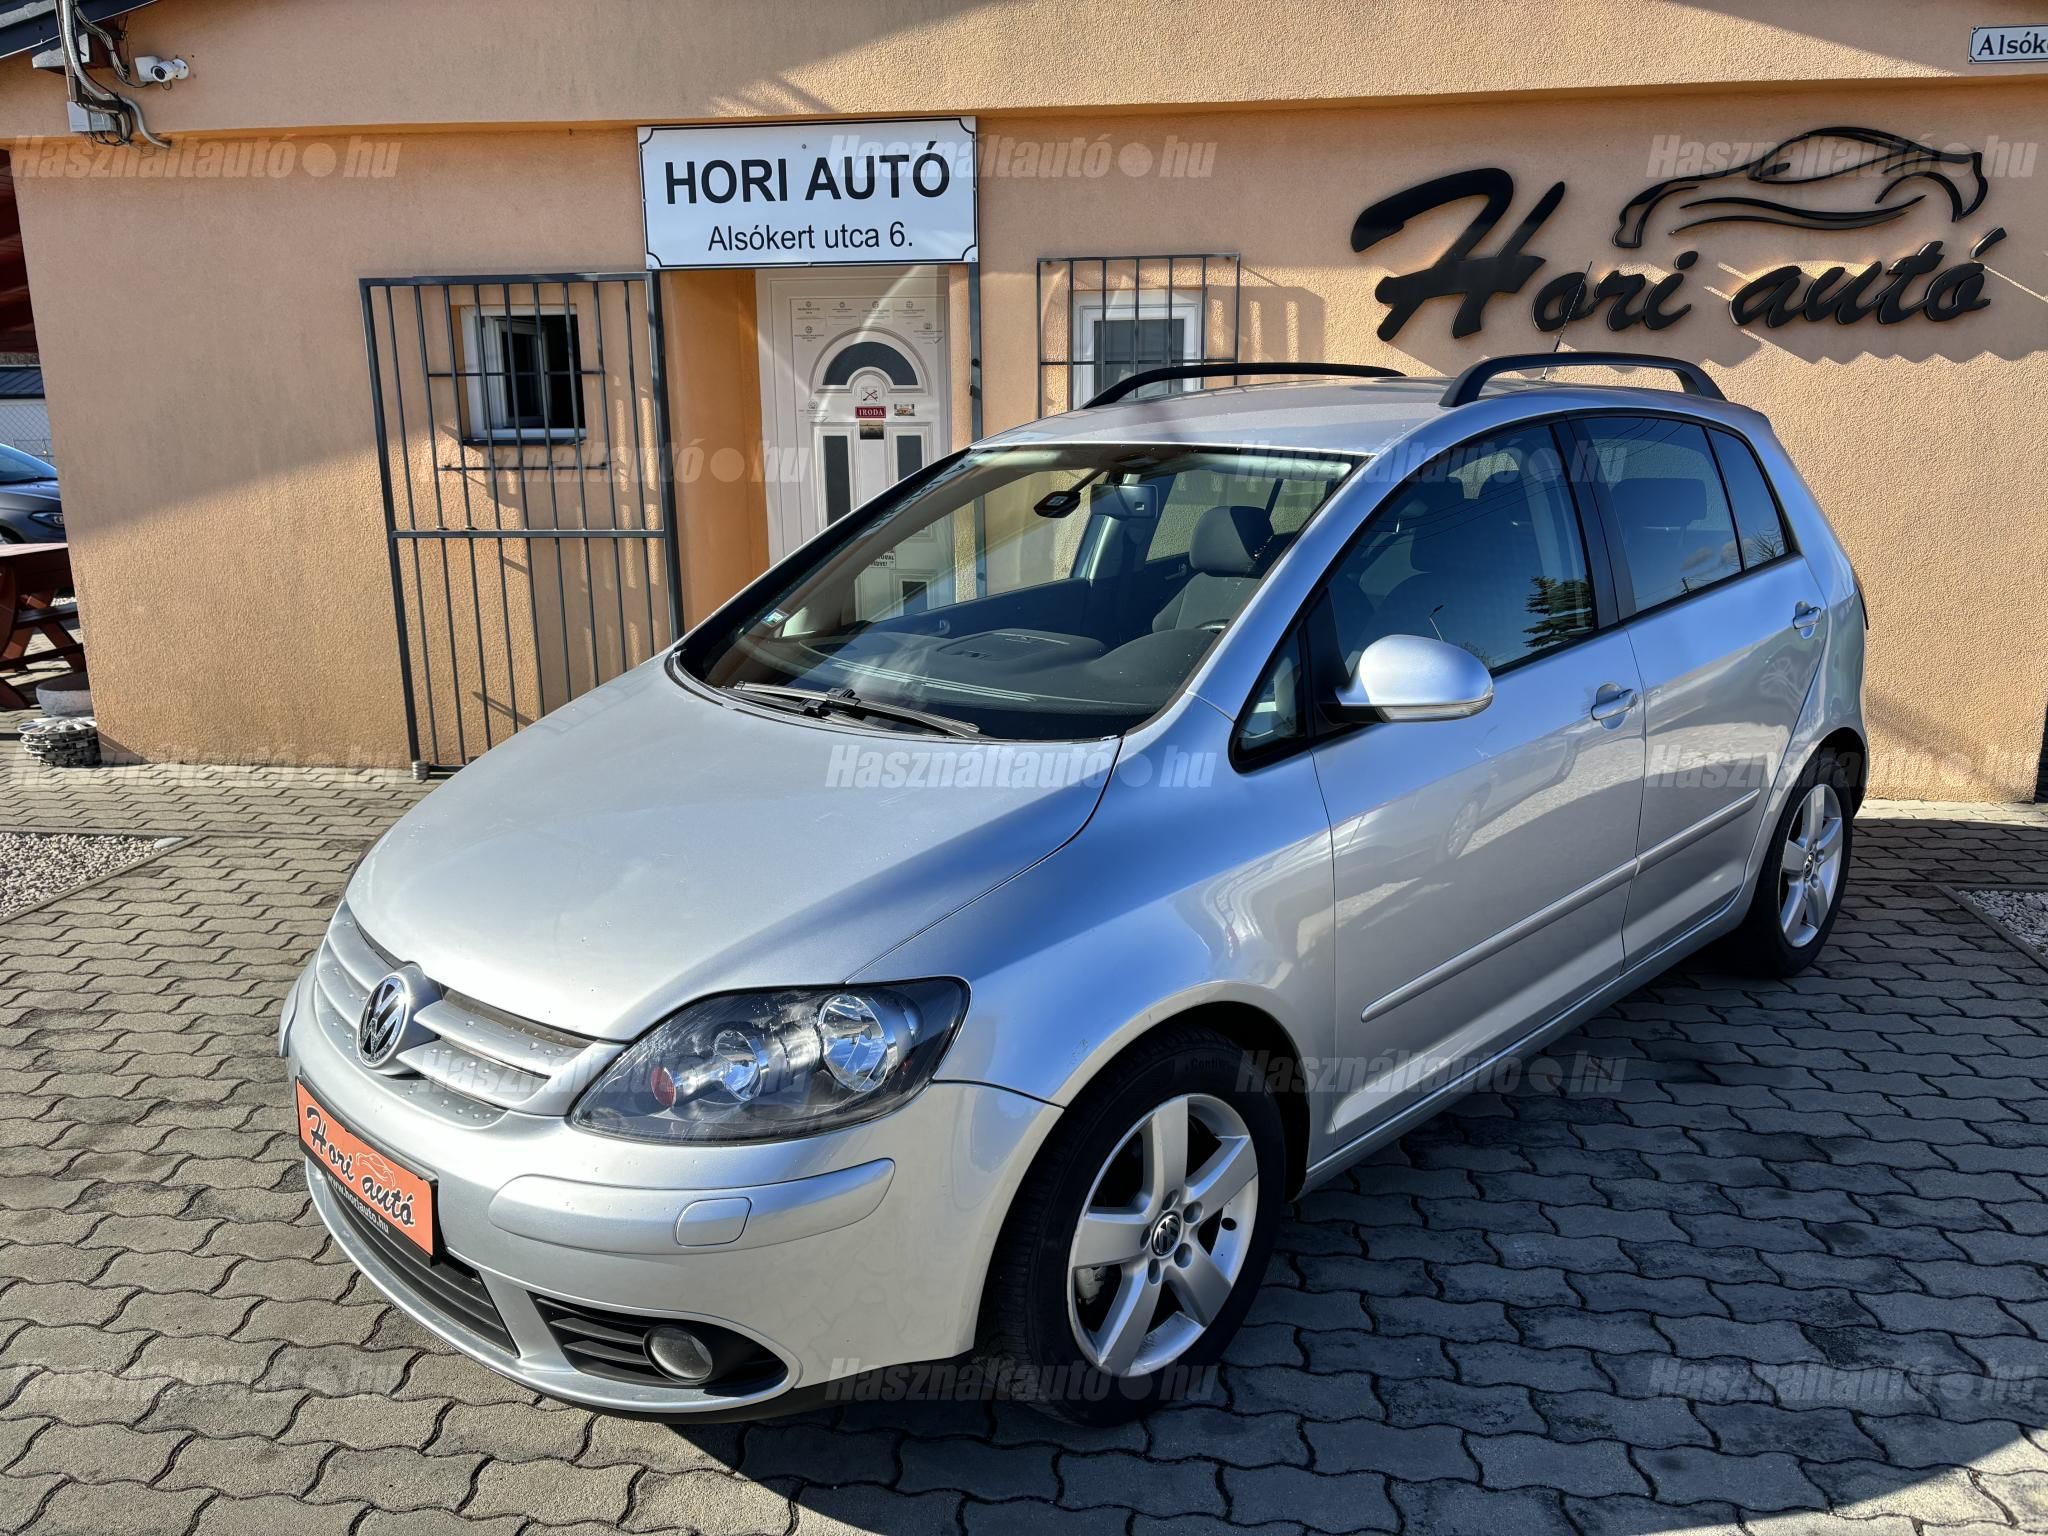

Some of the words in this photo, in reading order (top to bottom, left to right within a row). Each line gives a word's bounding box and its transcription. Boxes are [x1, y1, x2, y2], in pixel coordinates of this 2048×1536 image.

[1977, 31, 2048, 56] Alsók
[665, 158, 788, 205] HORI
[805, 141, 950, 200] AUTÓ
[708, 225, 815, 251] Alsókert
[824, 225, 880, 249] utca
[889, 221, 914, 248] 6.
[1350, 168, 1700, 343] Hori
[1730, 227, 2008, 328] autó
[859, 408, 884, 416] IRODA
[306, 1105, 355, 1182] Hori
[361, 1174, 416, 1227] autó
[327, 1173, 390, 1236] www.horiauto.hu
